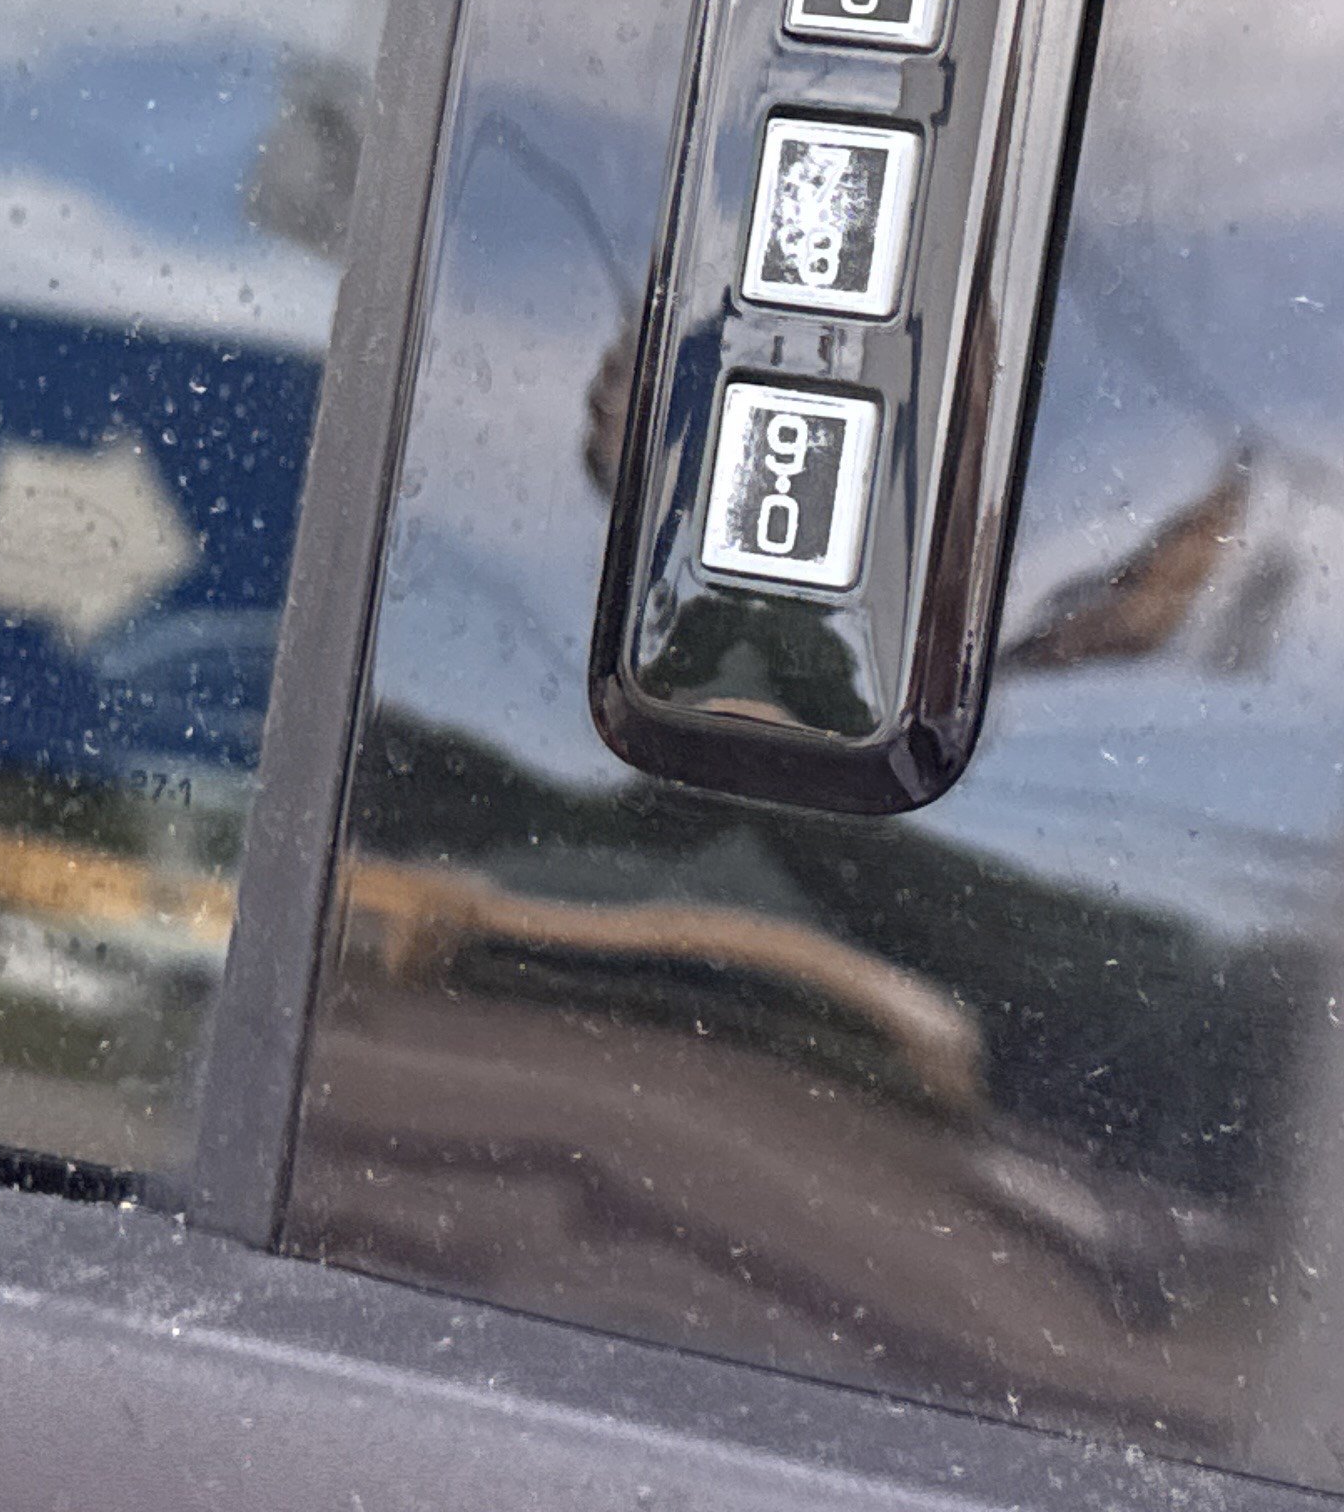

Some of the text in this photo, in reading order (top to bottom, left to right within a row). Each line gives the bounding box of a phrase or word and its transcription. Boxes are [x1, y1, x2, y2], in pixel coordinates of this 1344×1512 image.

[799, 225, 843, 286] 8
[765, 414, 808, 476] 9
[757, 494, 799, 554] 0
